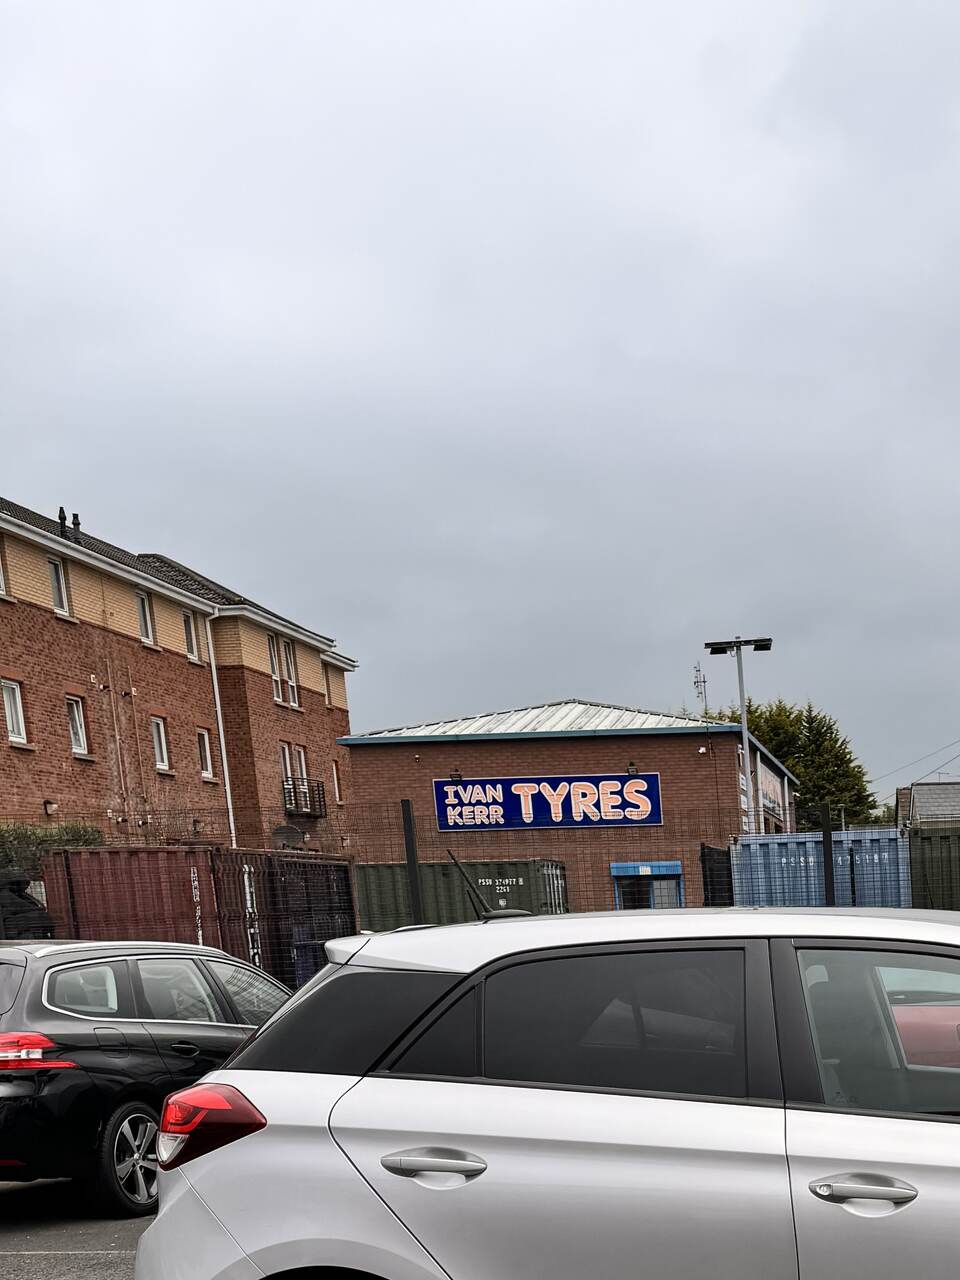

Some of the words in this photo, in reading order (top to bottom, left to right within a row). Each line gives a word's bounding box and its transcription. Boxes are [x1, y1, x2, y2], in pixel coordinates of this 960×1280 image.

[444, 784, 503, 804] IVAN
[511, 779, 652, 823] TYRES
[446, 805, 504, 825] KERR
